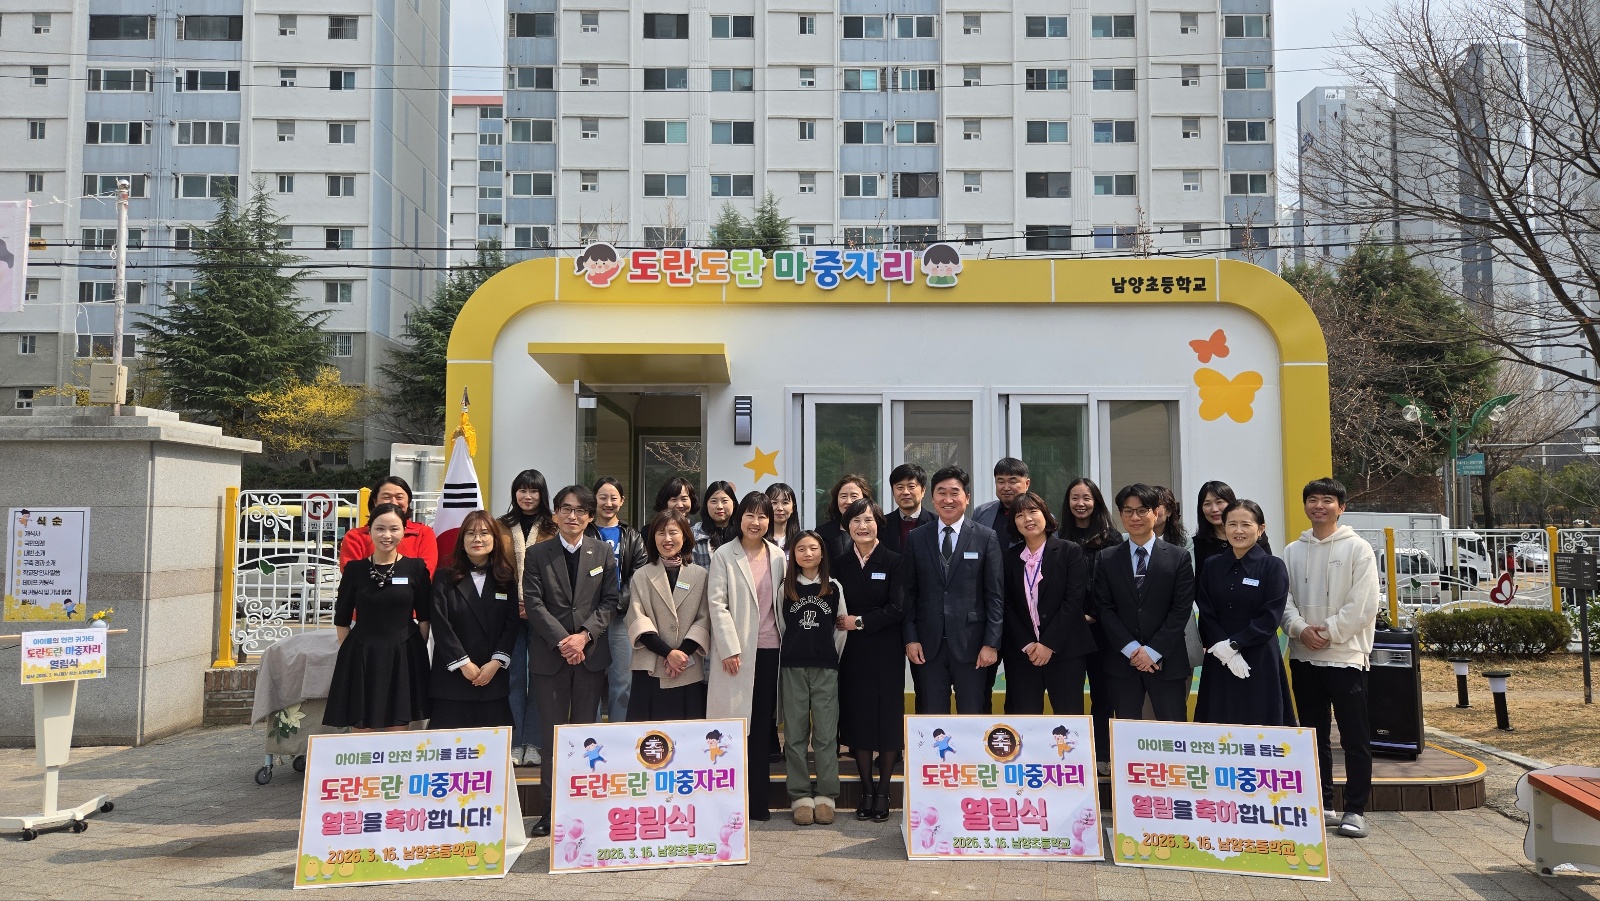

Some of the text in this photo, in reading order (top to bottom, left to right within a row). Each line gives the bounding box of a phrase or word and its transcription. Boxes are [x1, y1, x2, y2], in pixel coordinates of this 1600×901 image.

[629, 248, 915, 289] 도란도란 마중자리
[1111, 276, 1207, 294] 남양초등학교
[37, 516, 62, 526] 식 순
[50, 659, 78, 669] 열림식
[644, 736, 665, 760] 축
[992, 731, 1011, 753] 축
[1138, 738, 1286, 758] 아이들의 안전 귀가를 돕는
[336, 747, 480, 765] 아이들의 안전 귀가를 돕는
[321, 770, 493, 802] 도란도란 마중자리
[570, 768, 736, 799] 도란도란 마중자리
[922, 764, 1085, 788] 도란도란 마중자리
[1127, 762, 1303, 794] 도란도란 마중자리
[321, 807, 492, 836] 열림을 축하합니다!
[608, 804, 696, 842] 열림식
[961, 797, 1049, 832] 열림식
[1132, 794, 1308, 828] 열림을 축하합니다!
[326, 843, 477, 864] 2026. 3. 16. 남양초등학교
[596, 842, 718, 860] 2026. 3. 16. 남양초등학교
[952, 836, 1072, 850] 2026. 3. 16. 남양초등학교
[1142, 832, 1297, 856] 2026. 3. 16. 남양초등학교
